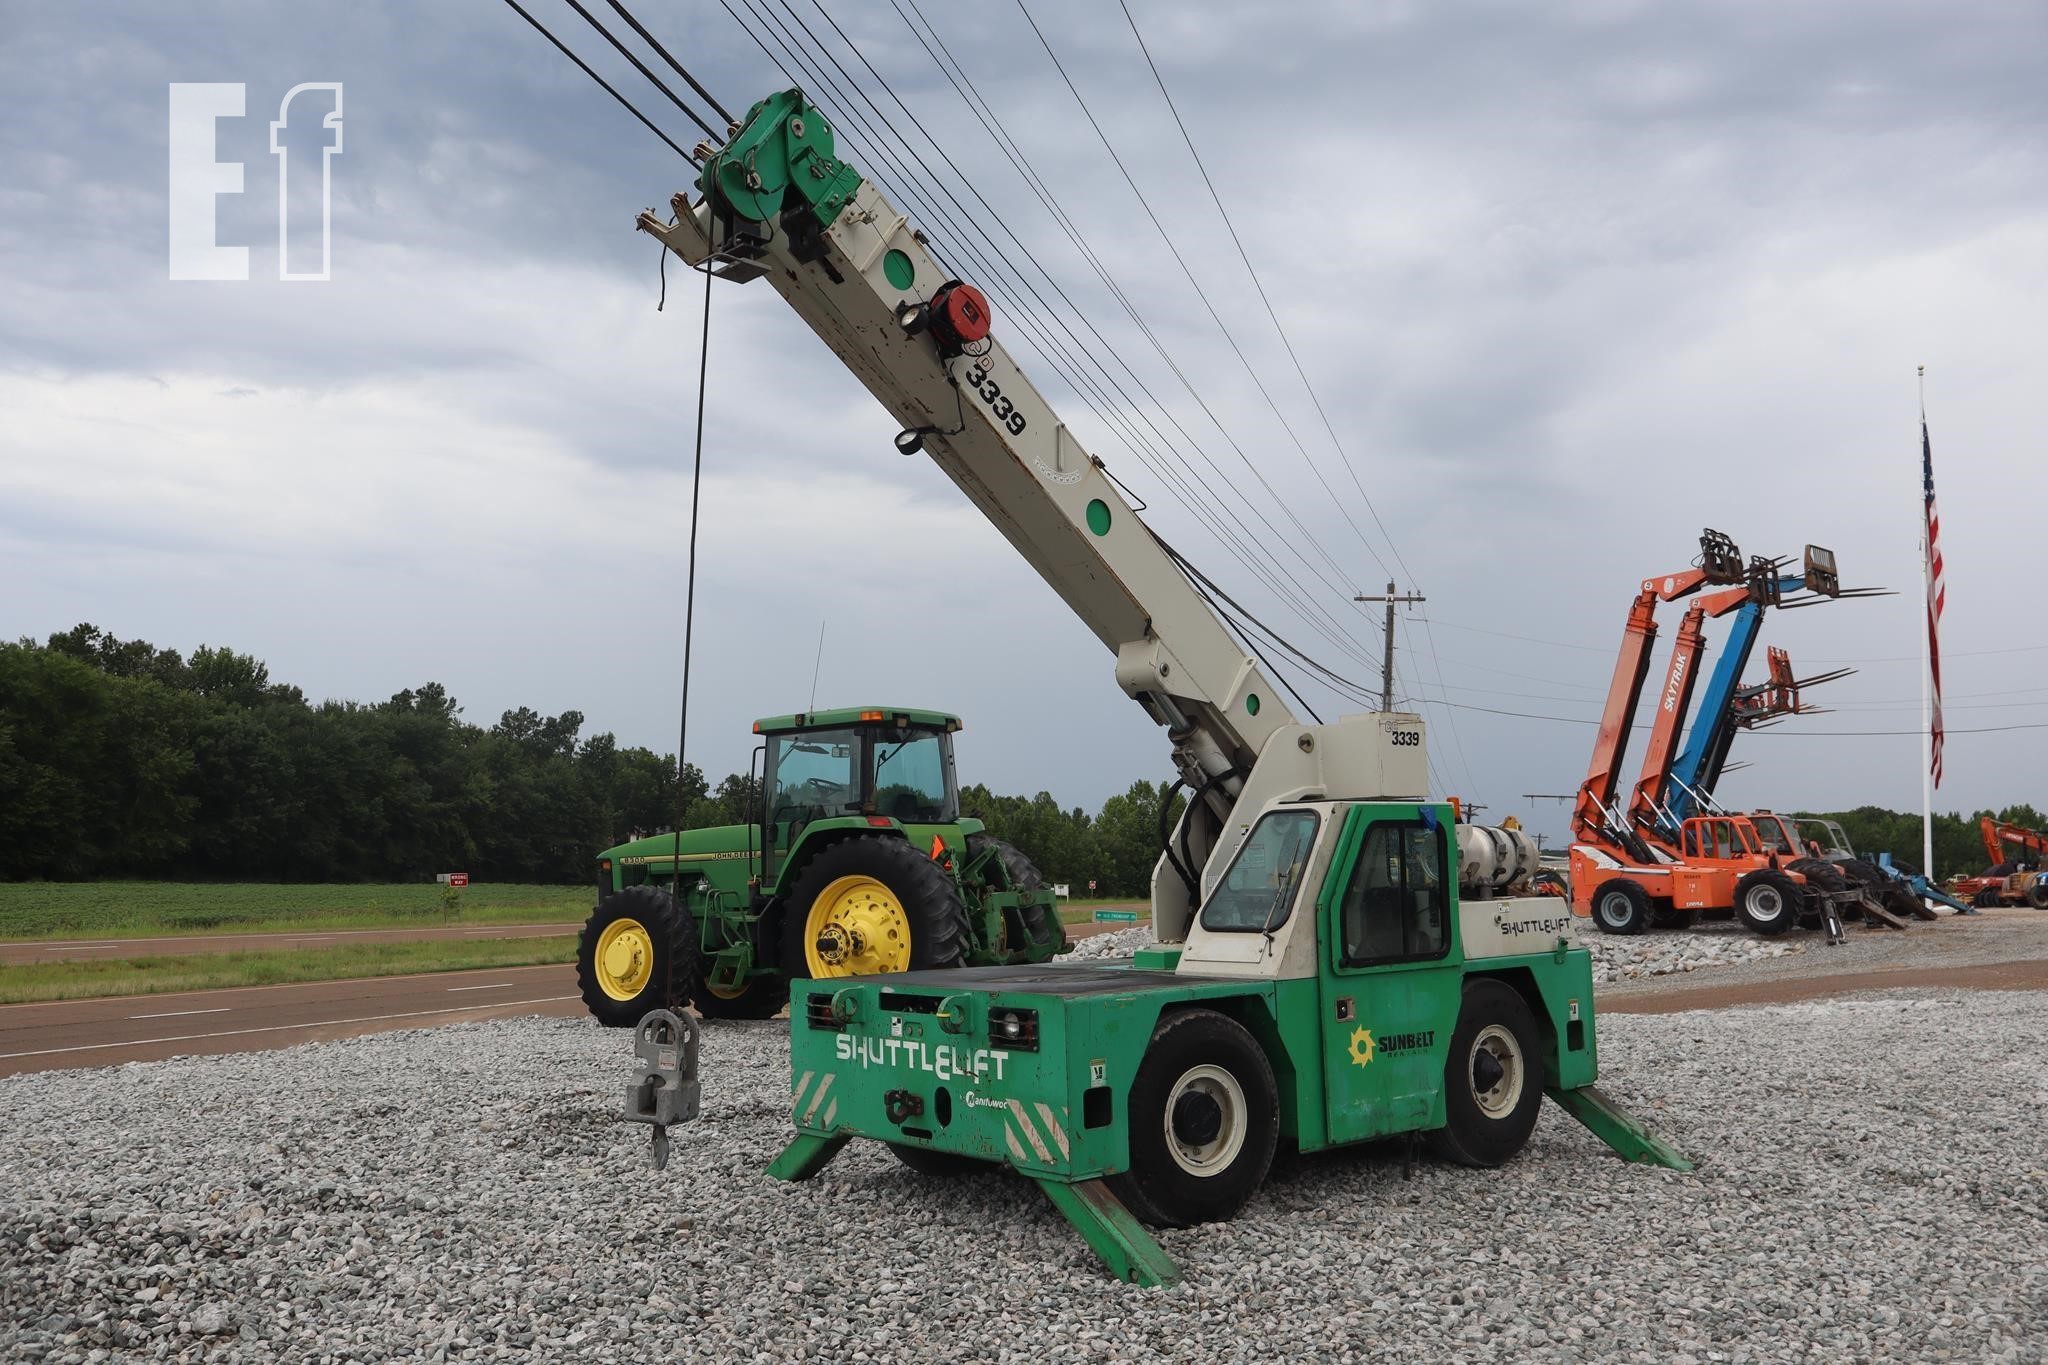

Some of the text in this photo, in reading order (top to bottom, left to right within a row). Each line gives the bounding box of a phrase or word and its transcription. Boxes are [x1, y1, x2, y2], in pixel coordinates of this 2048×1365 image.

[966, 363, 1027, 437] 3339
[1664, 652, 1687, 712] SKYTRAK
[1392, 730, 1420, 747] 3339
[712, 850, 759, 860] JOHN DEEE
[1501, 918, 1571, 937] SHUTTLELIFT
[1378, 1030, 1435, 1053] SUNBELT
[836, 1033, 1009, 1085] SHUTTLELIFT
